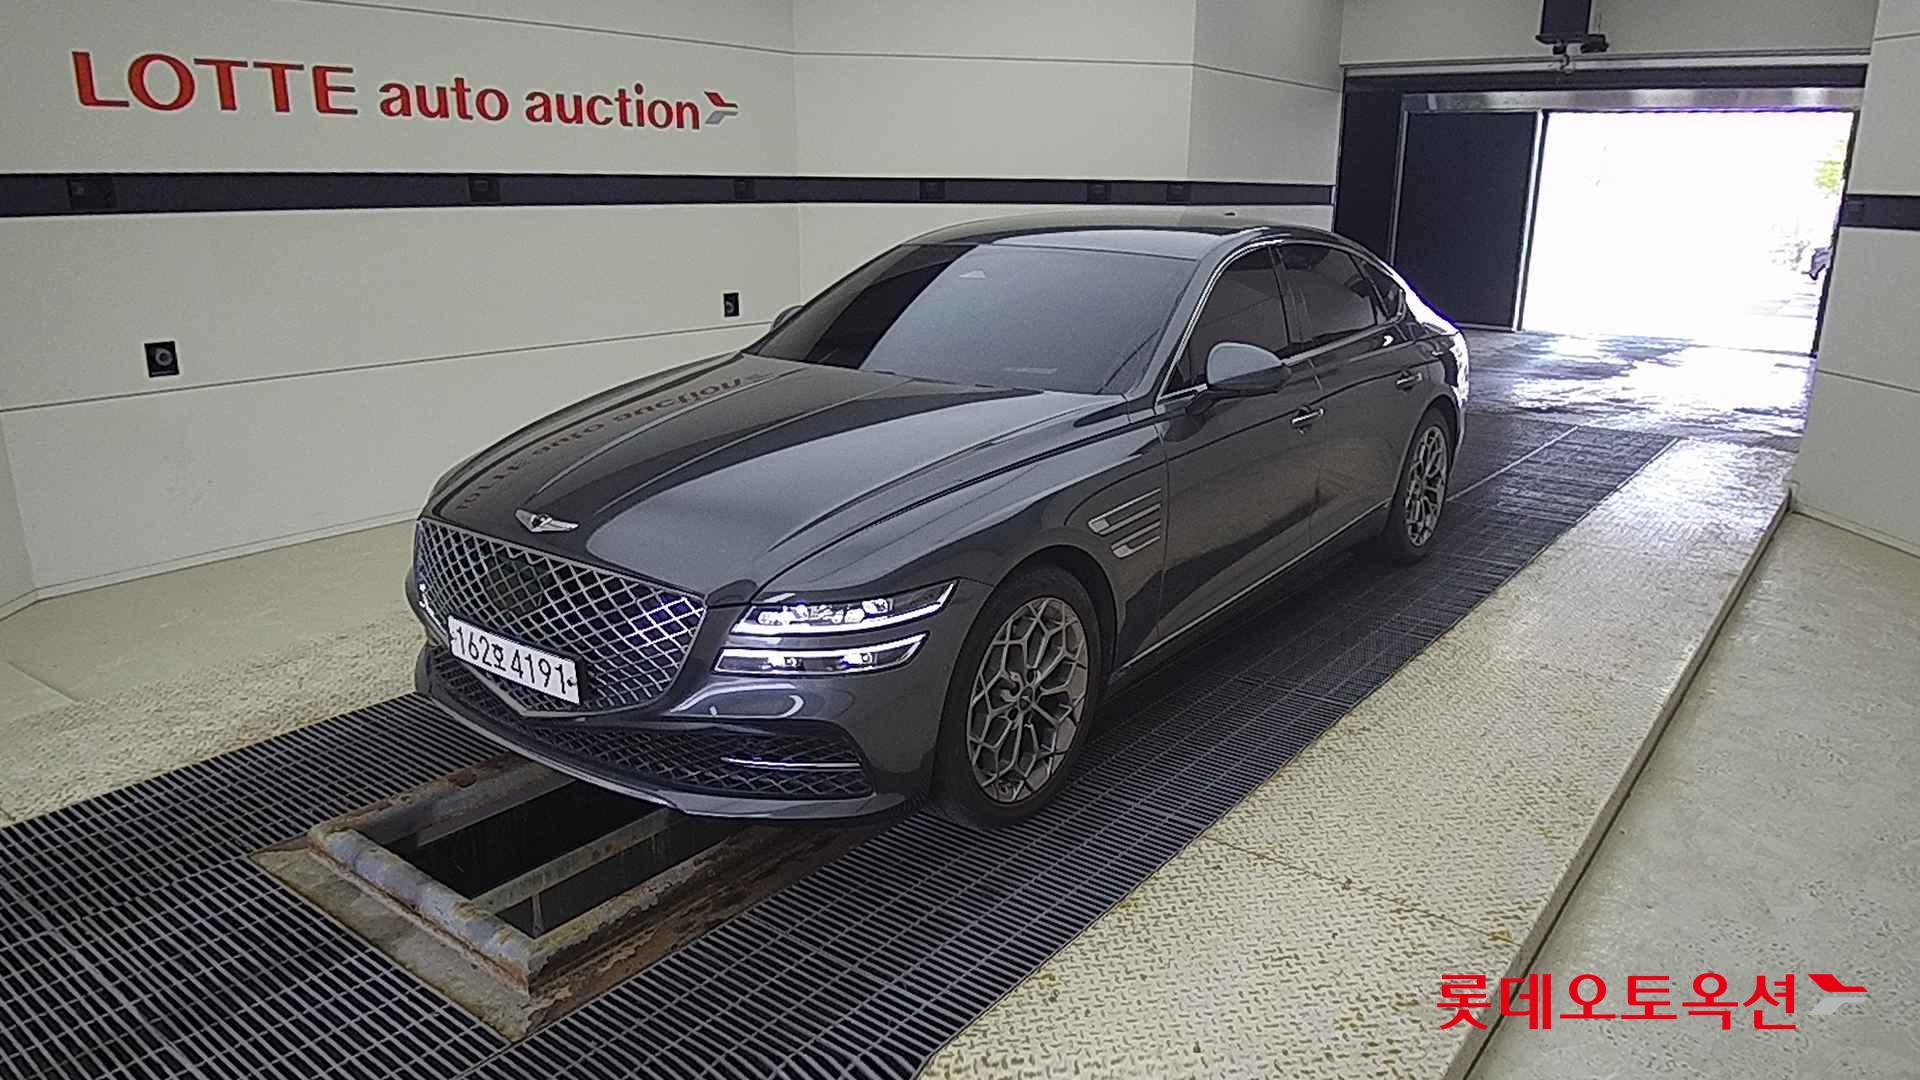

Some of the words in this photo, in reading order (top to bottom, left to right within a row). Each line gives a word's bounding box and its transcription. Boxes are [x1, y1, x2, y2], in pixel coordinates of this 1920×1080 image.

[72, 50, 358, 116] LOTTE
[379, 76, 510, 122] auto
[524, 82, 701, 131] auction
[510, 648, 566, 695] 4191
